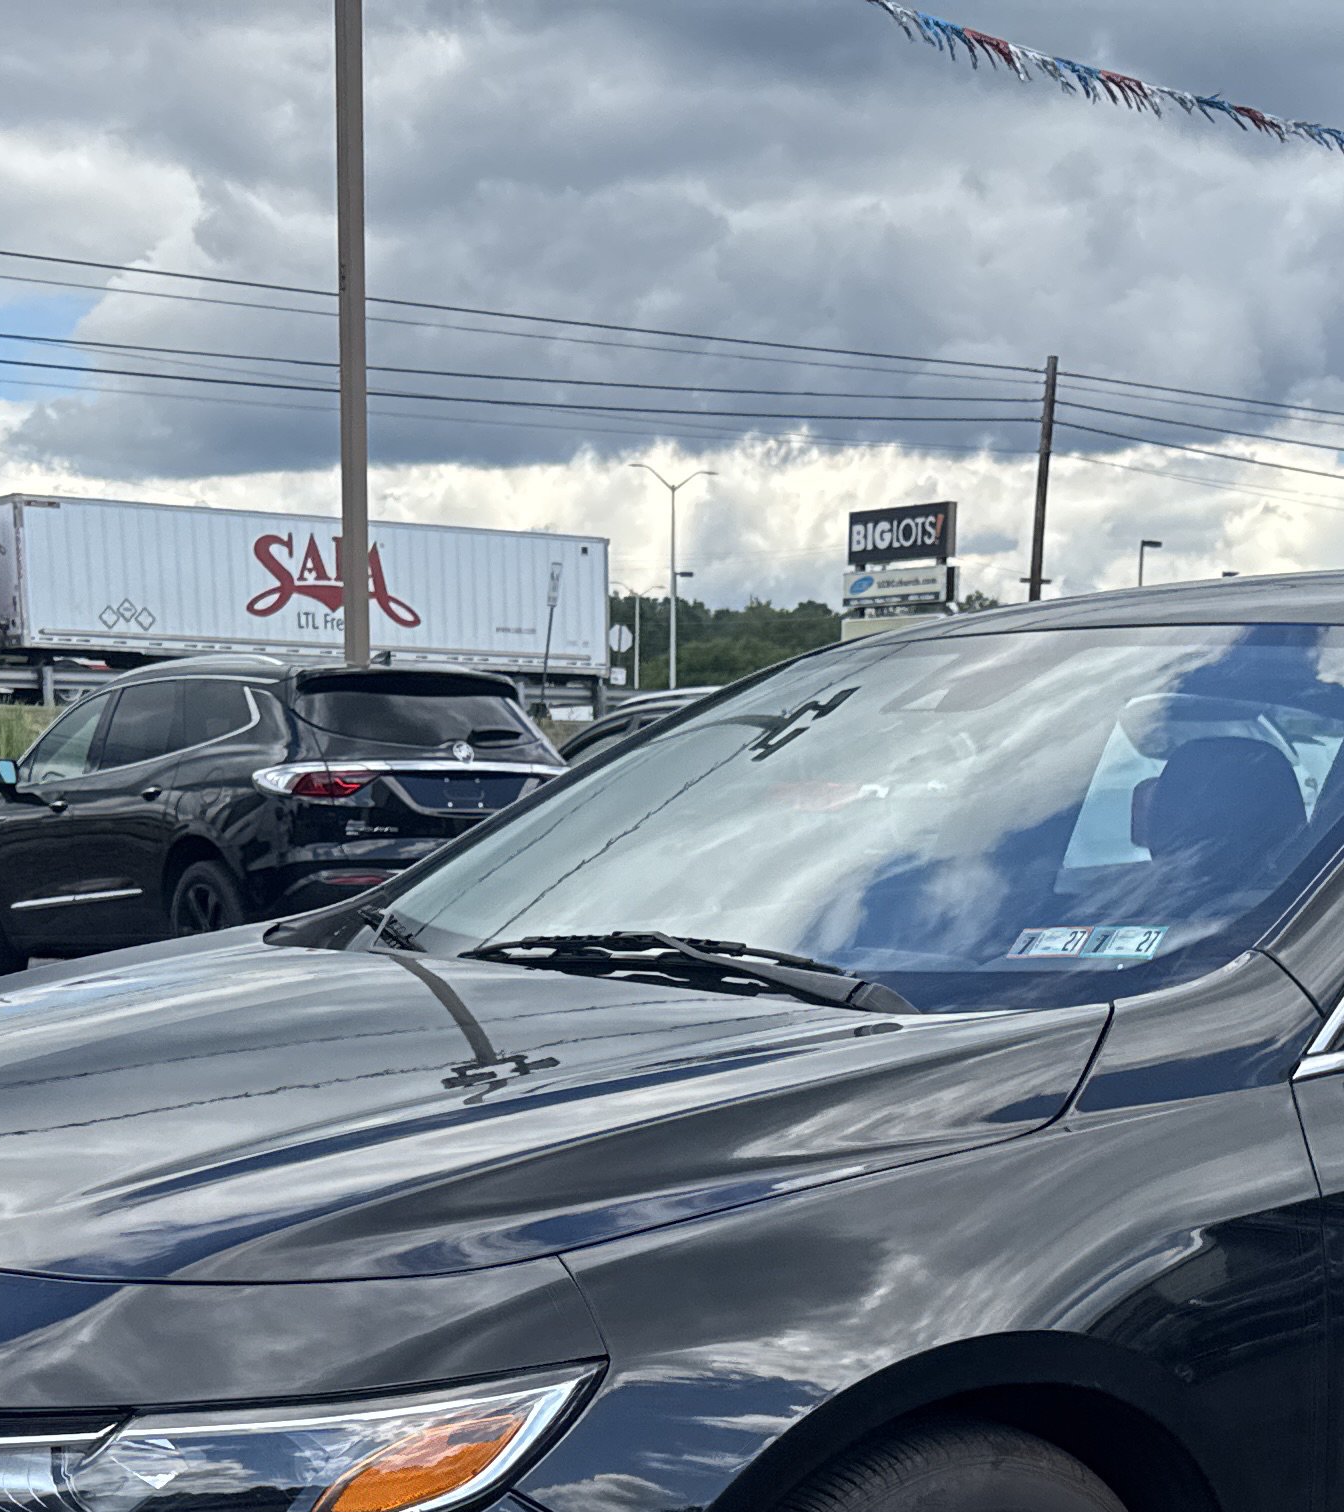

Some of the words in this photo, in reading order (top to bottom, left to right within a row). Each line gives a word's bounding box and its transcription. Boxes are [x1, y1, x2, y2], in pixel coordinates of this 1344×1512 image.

[297, 611, 319, 630] LTL
[1061, 930, 1087, 952] 27
[1135, 930, 1162, 953] 27
